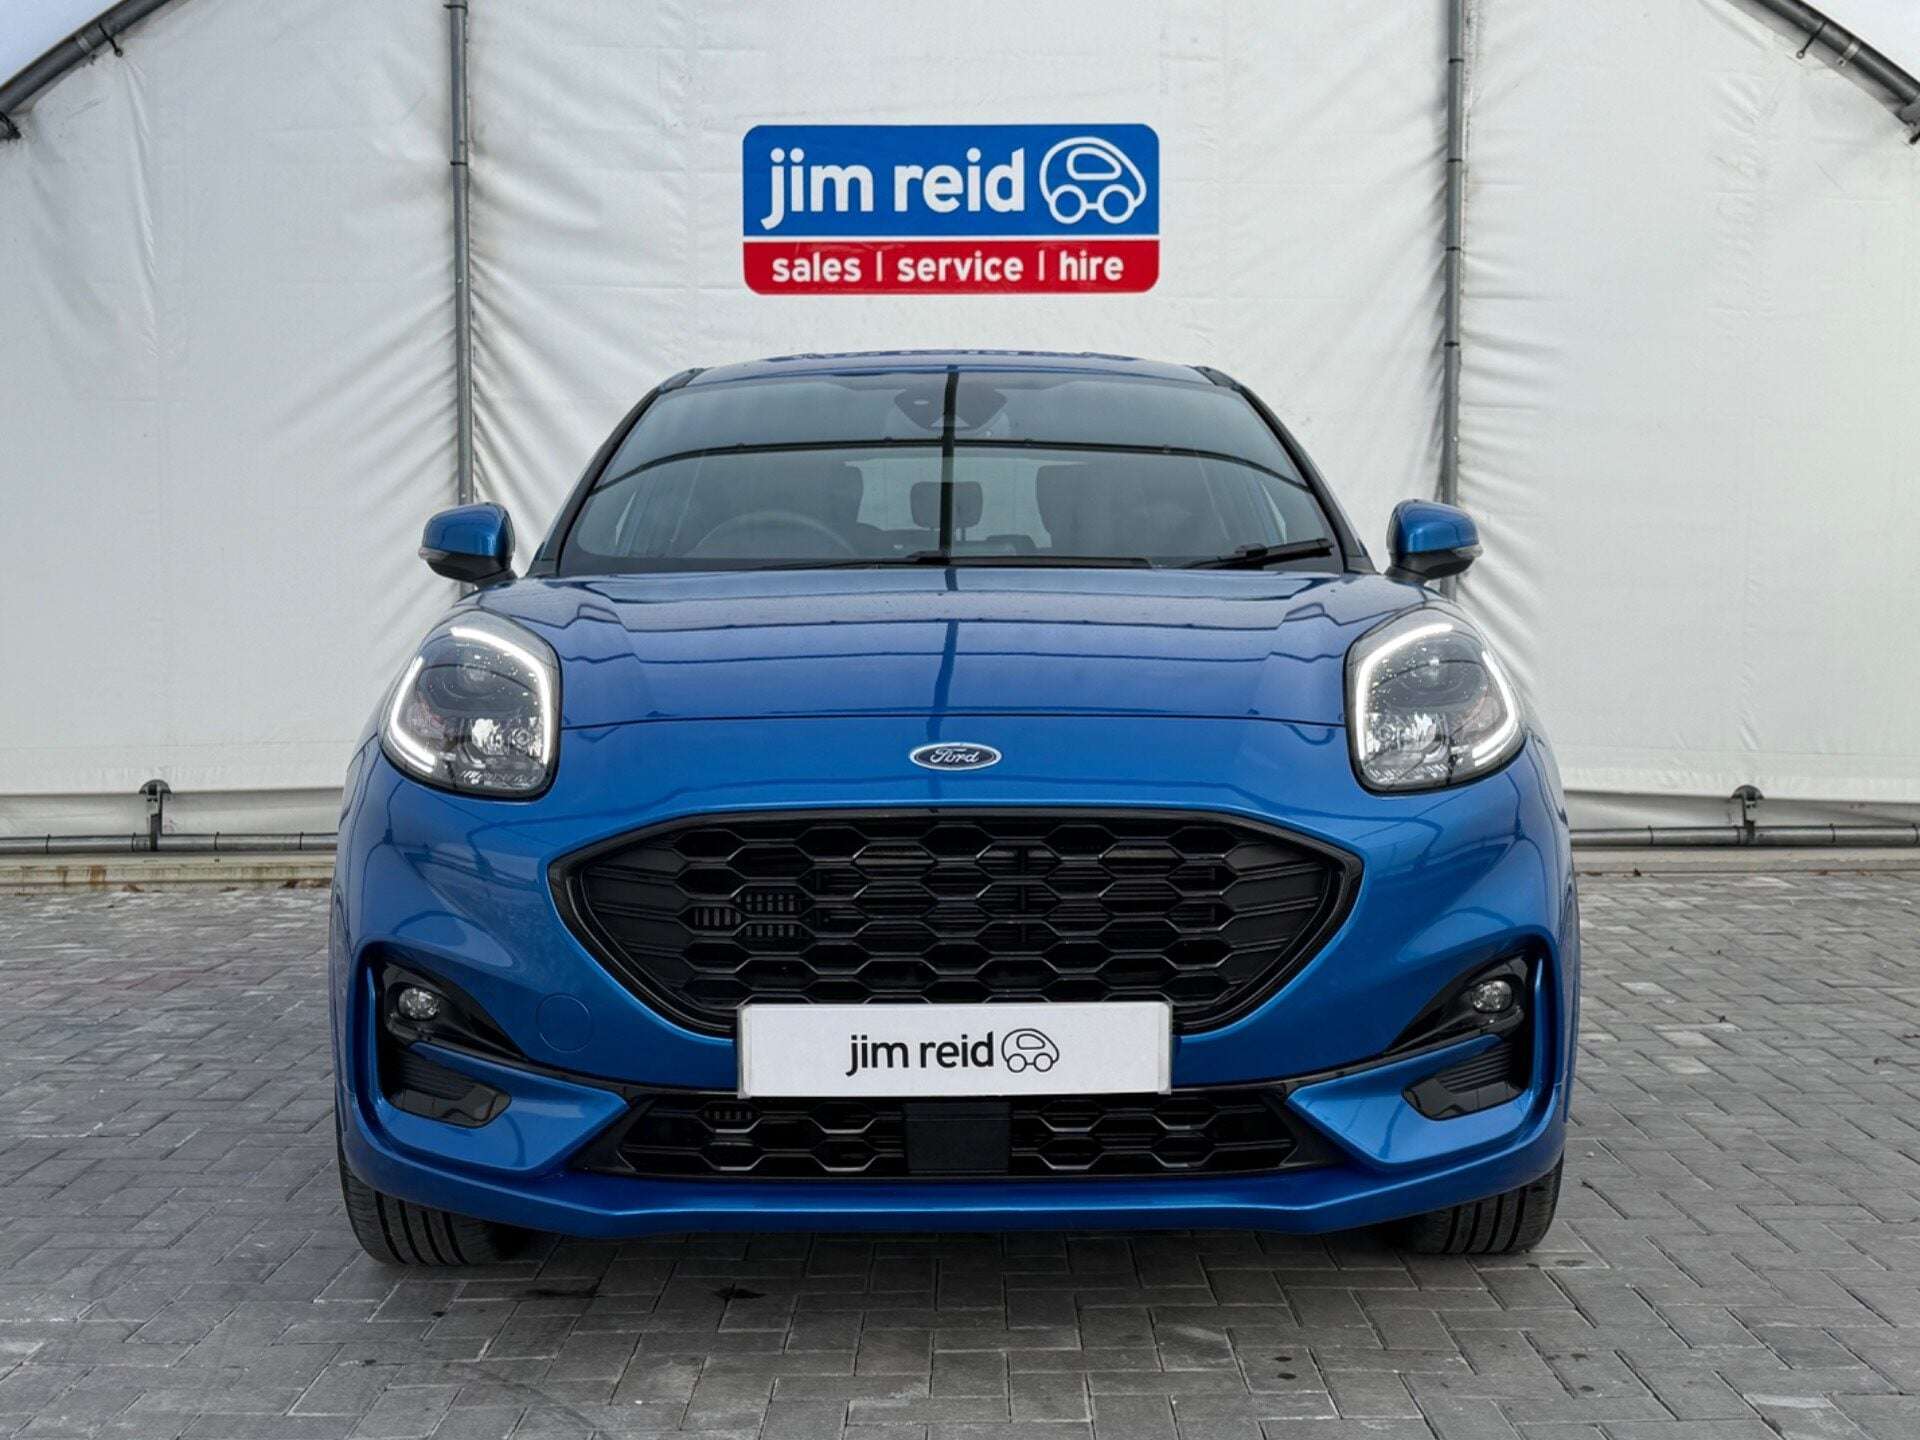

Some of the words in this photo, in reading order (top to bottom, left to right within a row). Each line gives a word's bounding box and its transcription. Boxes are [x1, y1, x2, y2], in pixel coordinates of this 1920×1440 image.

[761, 147, 874, 230] jim
[894, 147, 1025, 213] reid
[772, 251, 862, 282] sales
[897, 250, 1024, 282] service
[1059, 250, 1124, 281] hire
[930, 747, 979, 764] Ford
[845, 1034, 910, 1077] jim
[919, 1031, 994, 1069] reid
